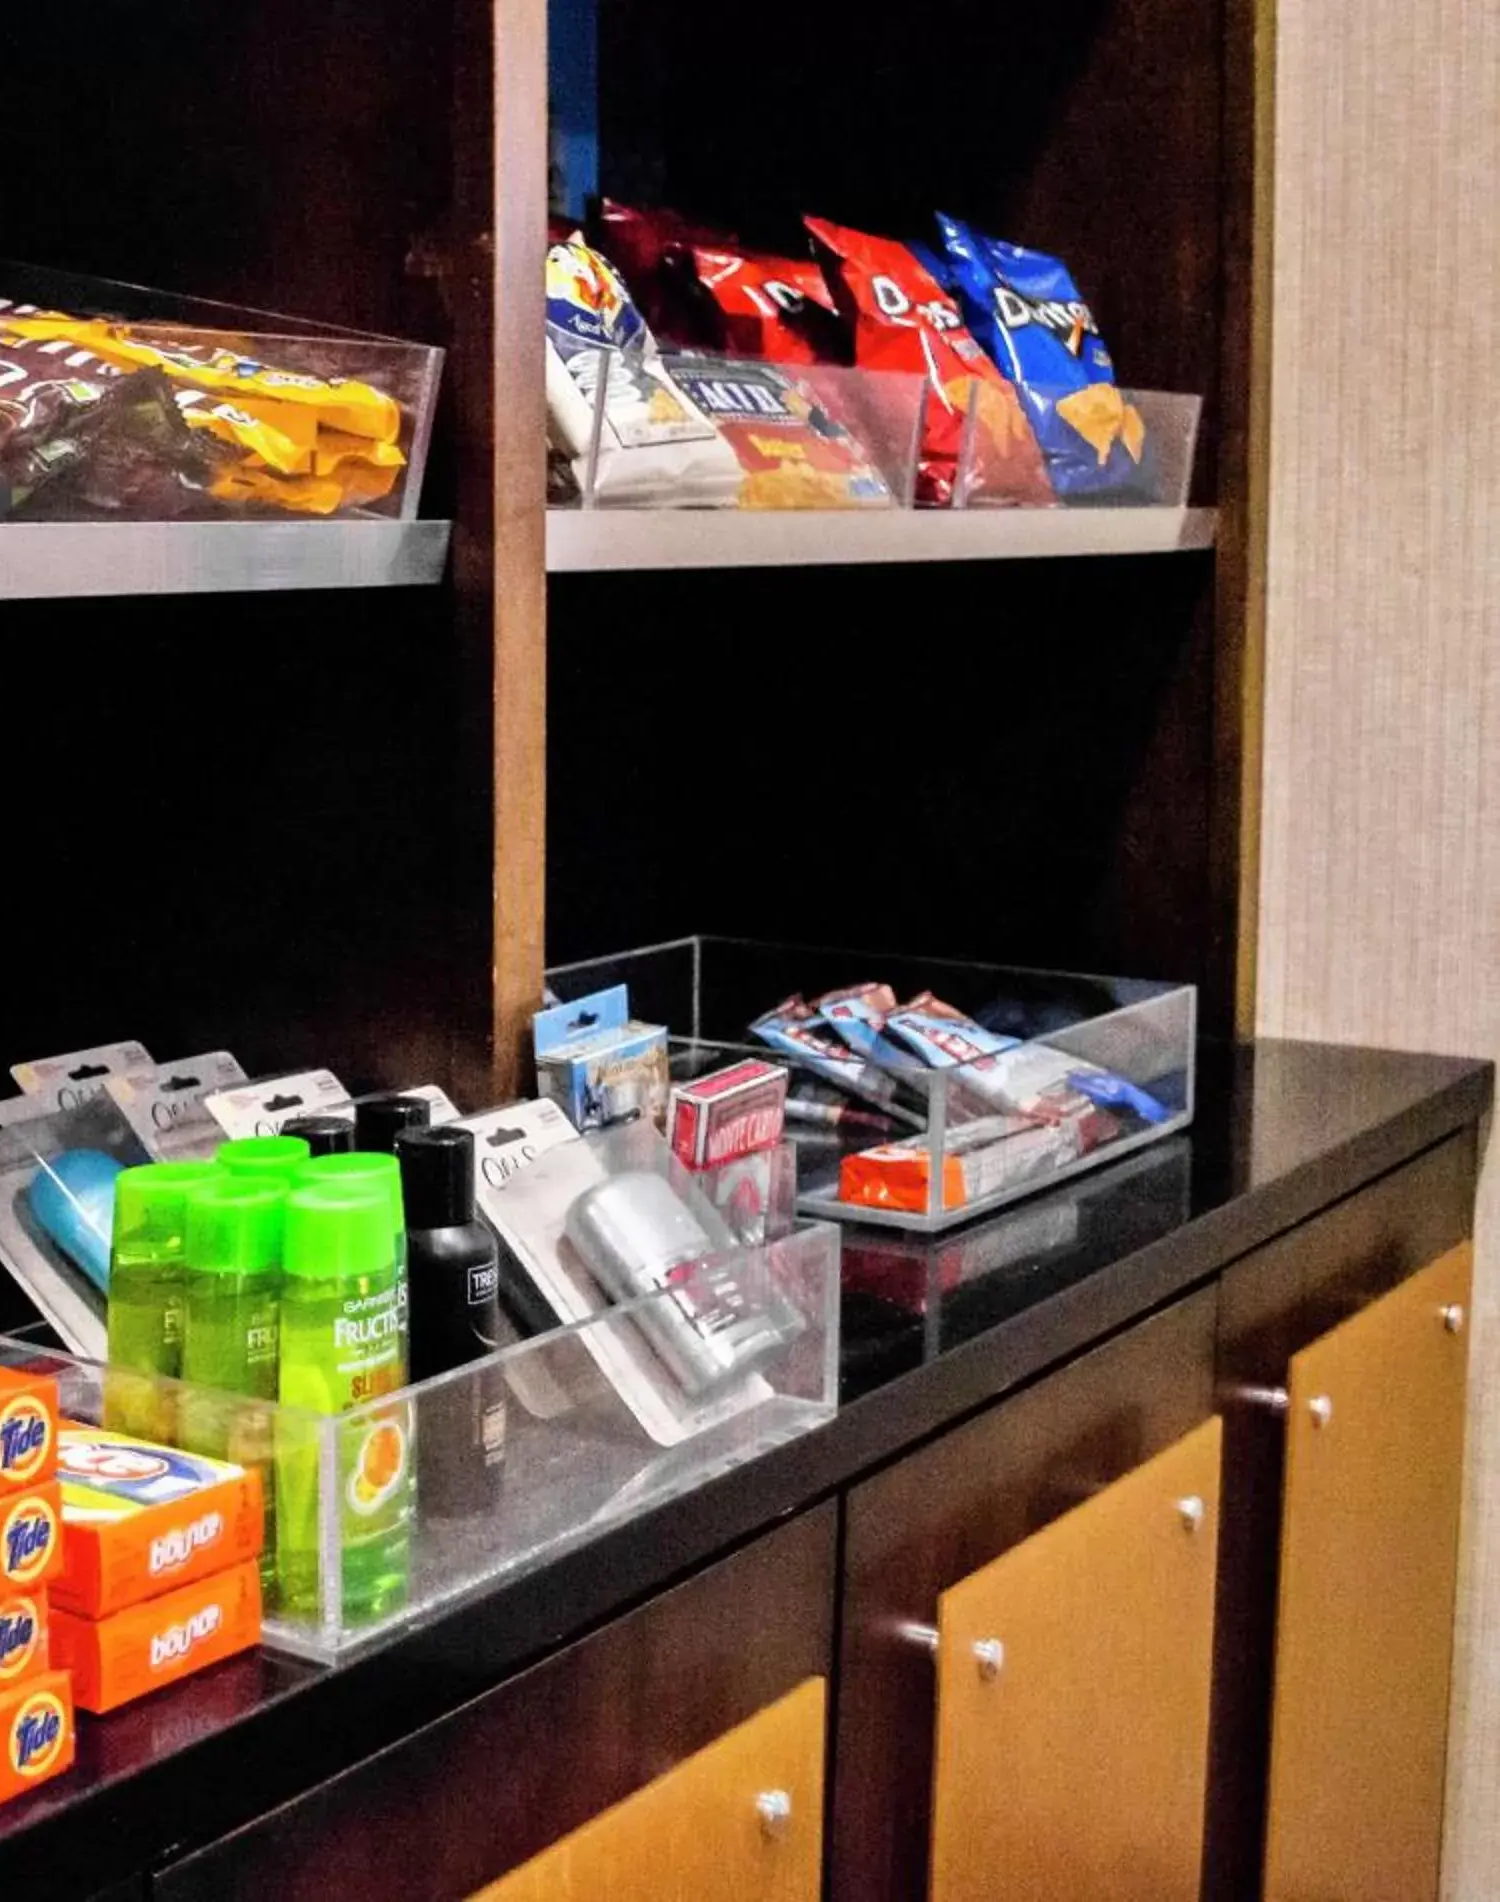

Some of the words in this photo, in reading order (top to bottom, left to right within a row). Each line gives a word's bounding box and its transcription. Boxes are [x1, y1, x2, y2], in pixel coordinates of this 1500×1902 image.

[0, 1415, 46, 1469] Tide
[6, 1516, 51, 1573] Tide
[15, 1710, 61, 1768] Tide
